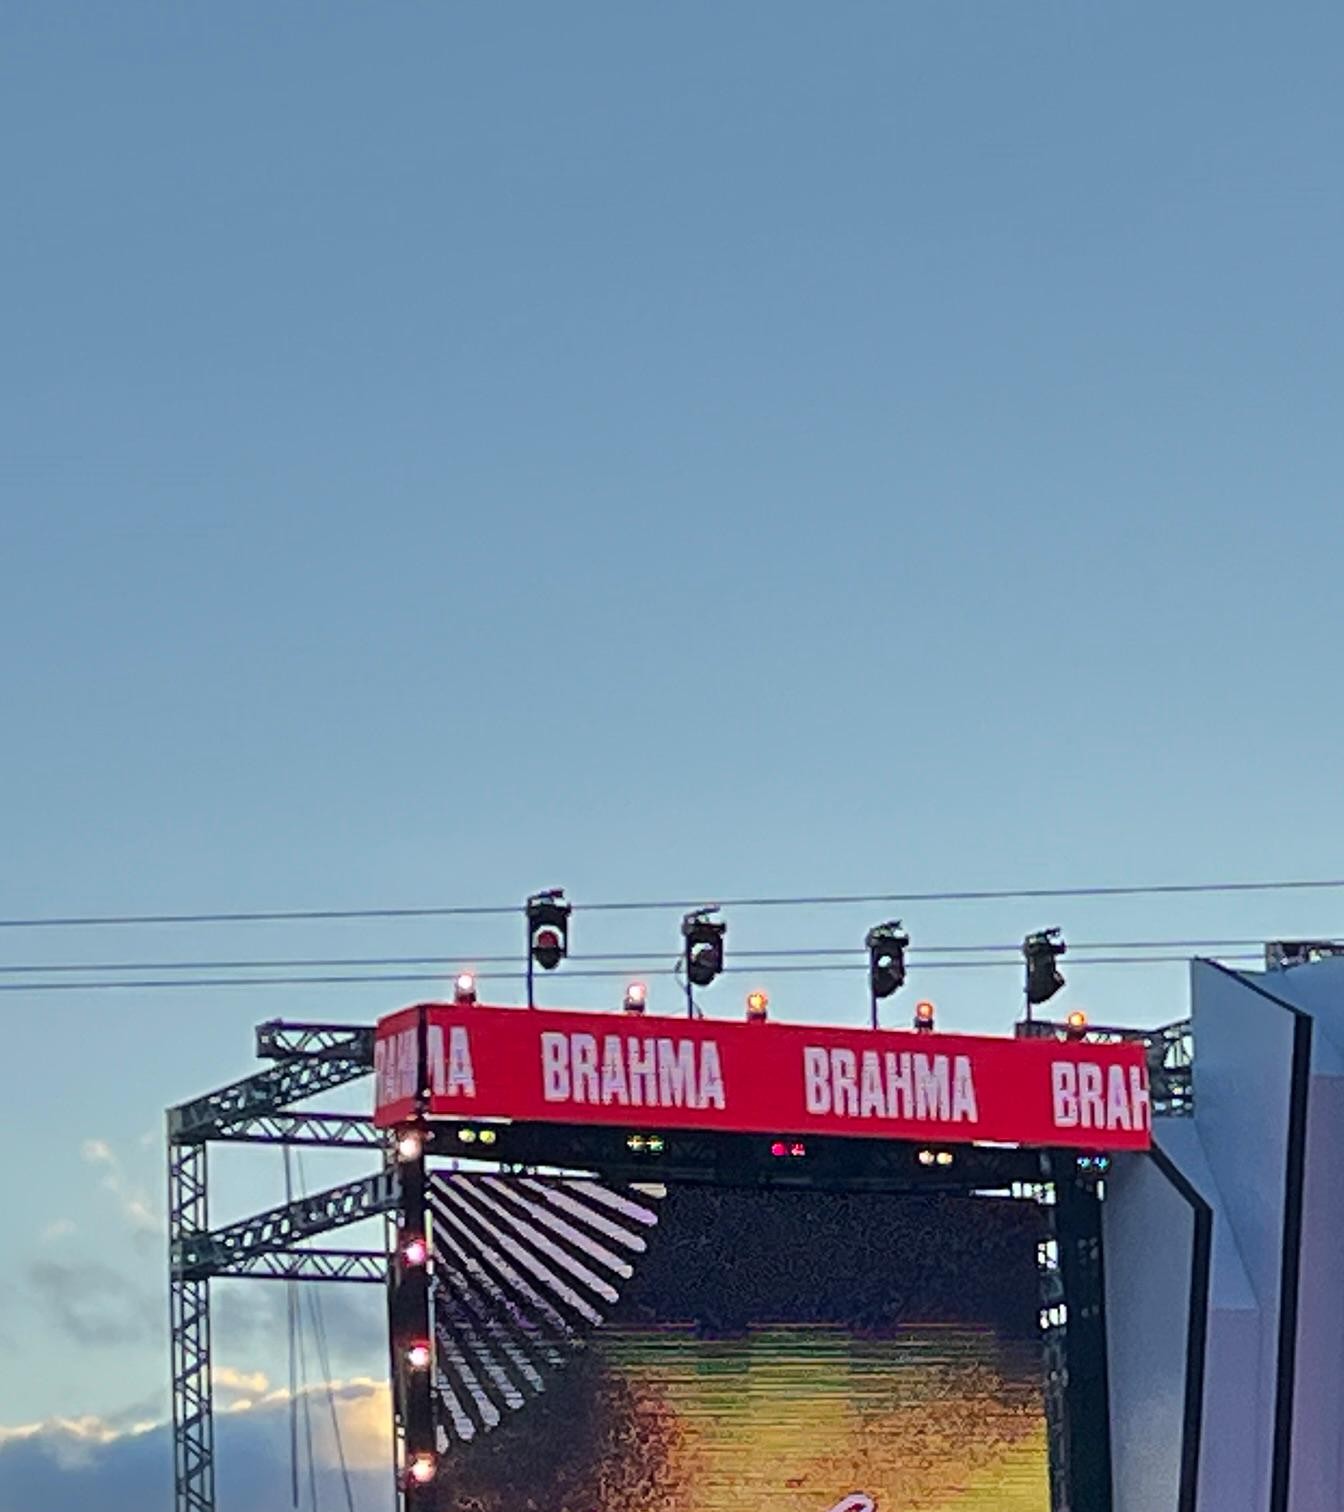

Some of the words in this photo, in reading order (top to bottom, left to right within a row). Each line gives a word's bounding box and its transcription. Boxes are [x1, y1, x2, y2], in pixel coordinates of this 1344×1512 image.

[541, 1033, 725, 1110] BRAHMA
[804, 1046, 978, 1123] BRAHMA
[1051, 1061, 1151, 1132] BRAH
